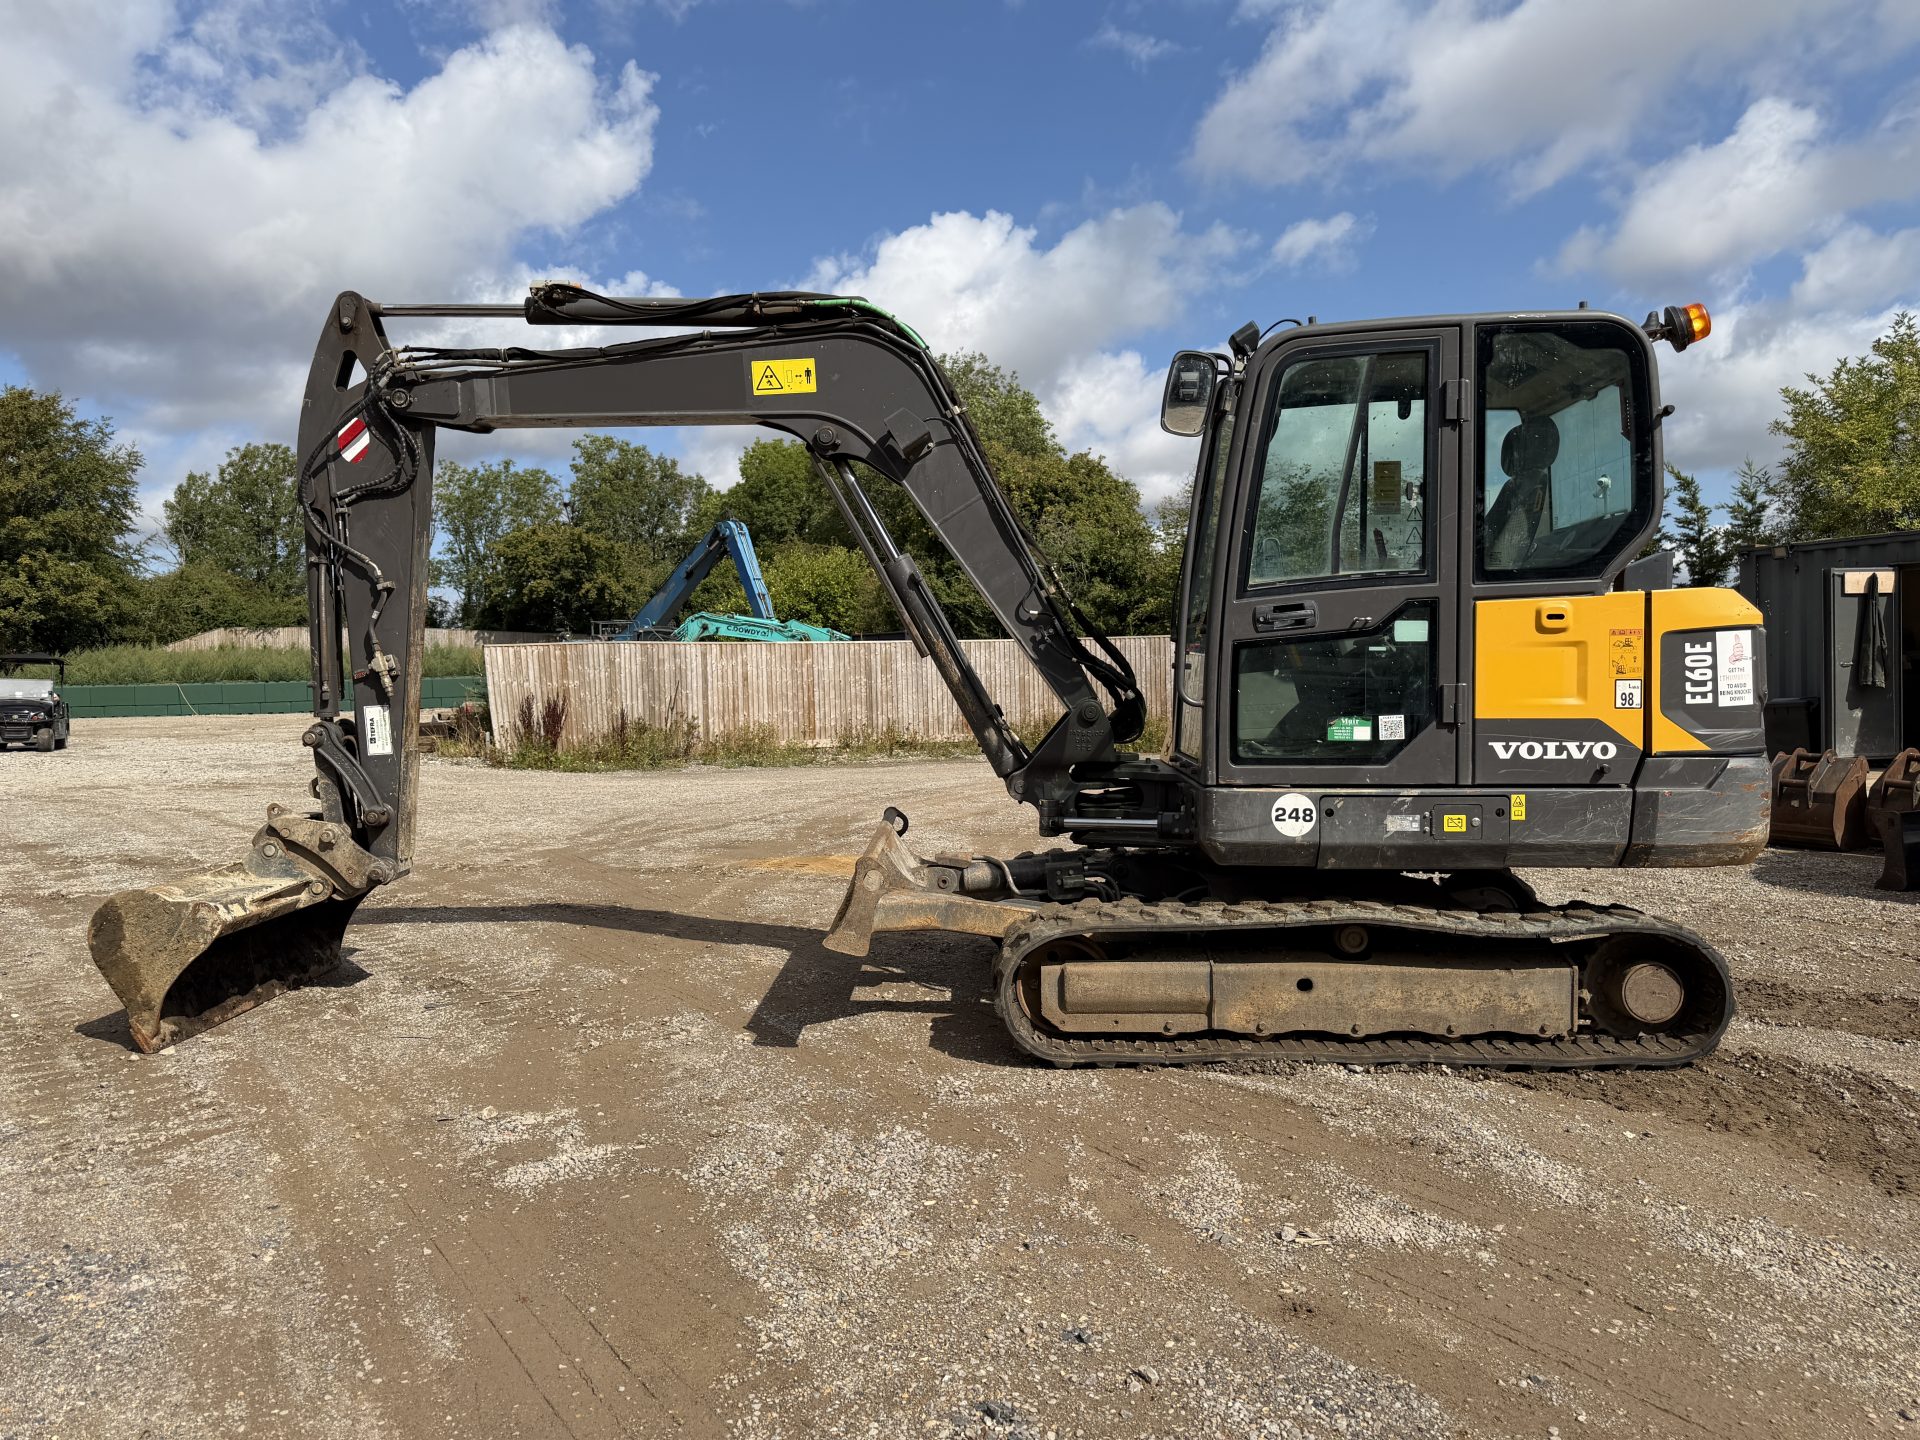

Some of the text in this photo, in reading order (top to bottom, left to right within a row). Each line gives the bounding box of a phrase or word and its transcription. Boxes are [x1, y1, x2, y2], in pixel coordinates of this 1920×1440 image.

[1685, 641, 1712, 704] EC60E
[1620, 692, 1634, 706] 98
[1488, 741, 1617, 759] VOLVO
[1274, 807, 1314, 823] 248
